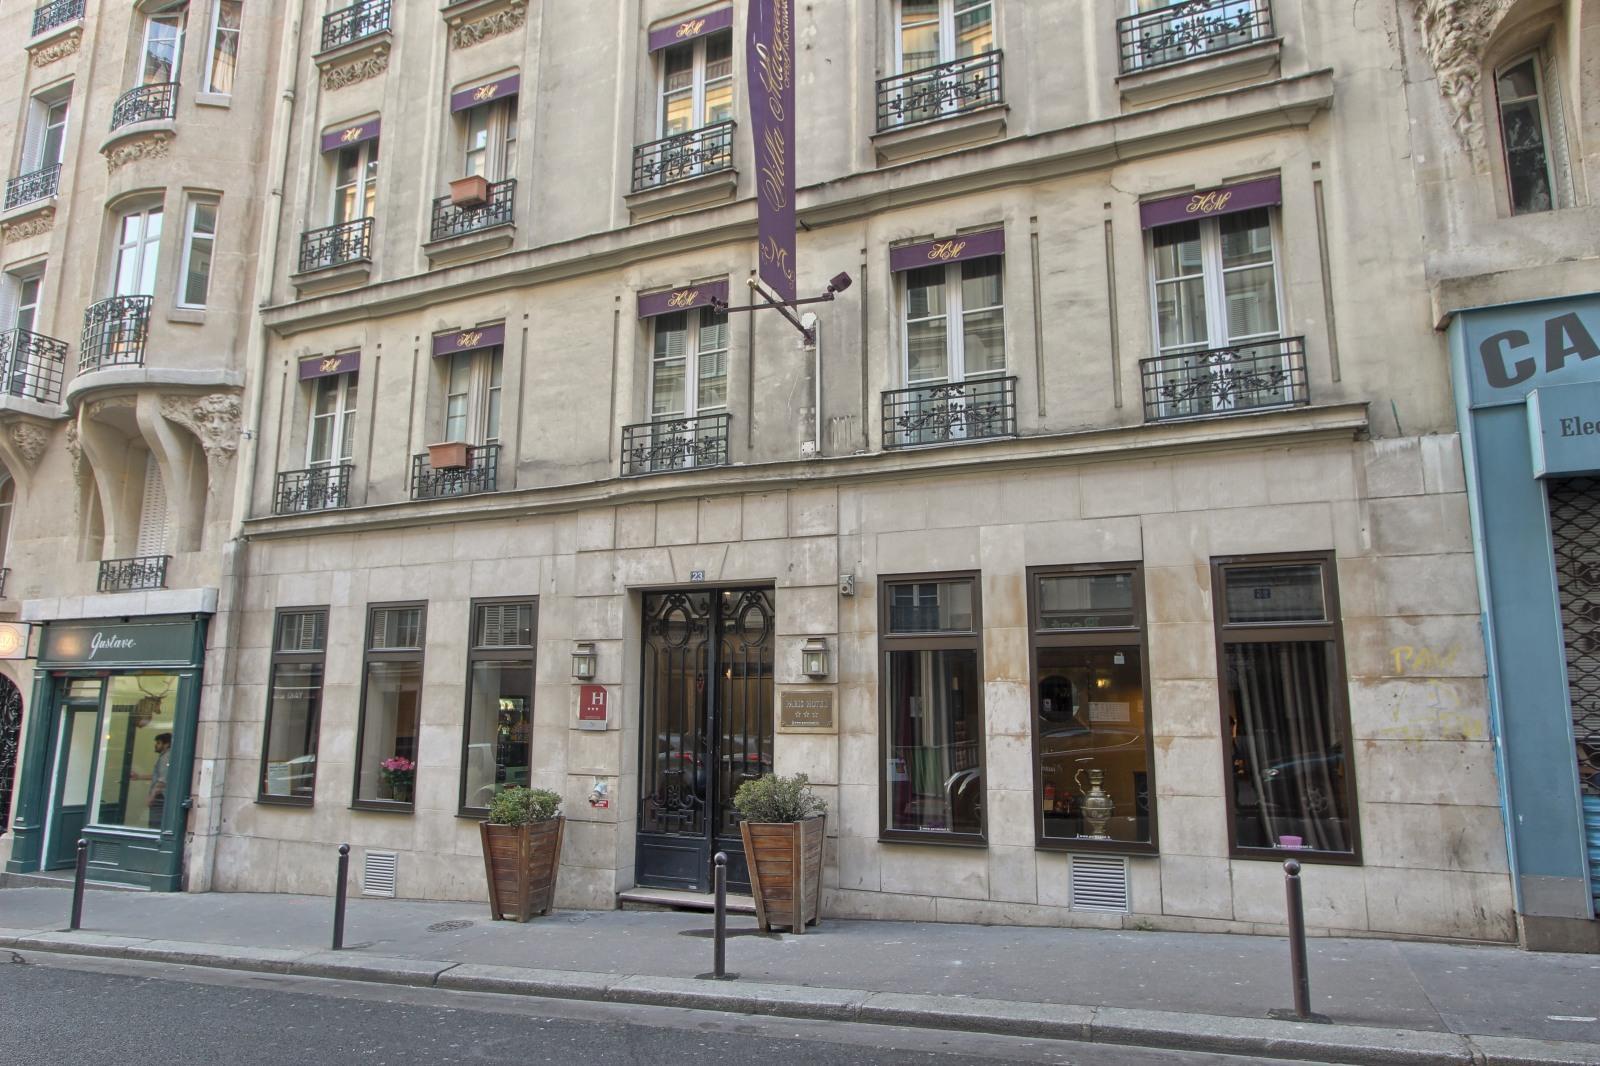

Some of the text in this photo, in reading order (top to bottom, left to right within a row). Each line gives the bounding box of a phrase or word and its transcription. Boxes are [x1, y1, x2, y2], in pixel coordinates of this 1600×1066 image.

[692, 571, 703, 581] 23
[88, 632, 136, 660] Gustave
[592, 692, 604, 705] H
